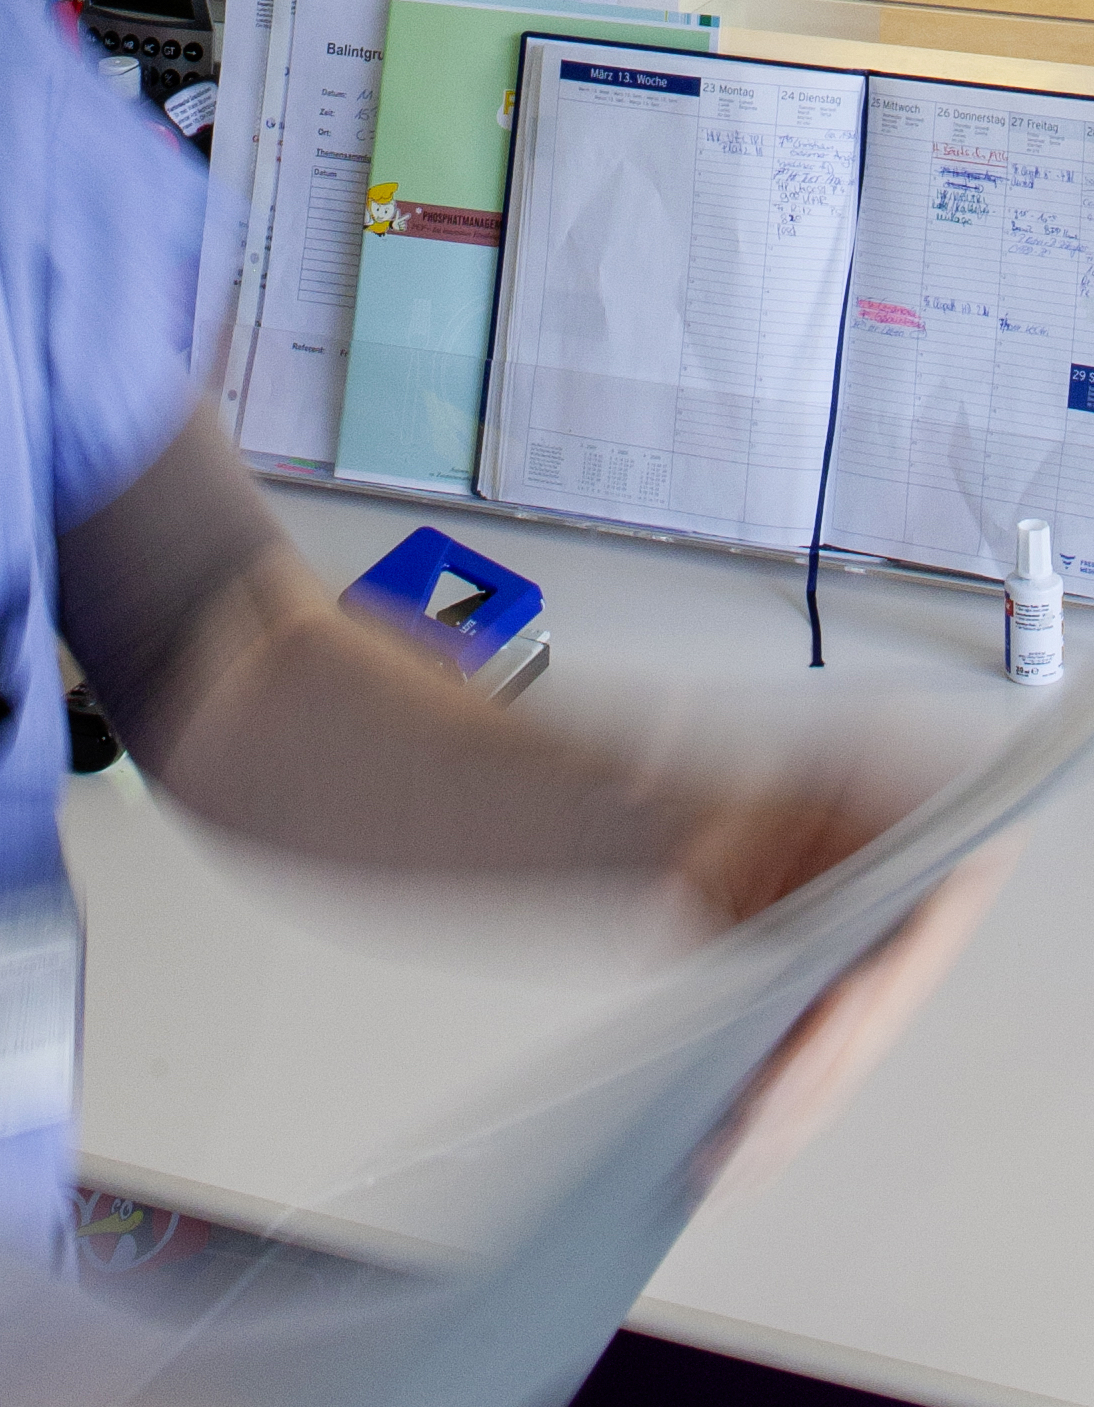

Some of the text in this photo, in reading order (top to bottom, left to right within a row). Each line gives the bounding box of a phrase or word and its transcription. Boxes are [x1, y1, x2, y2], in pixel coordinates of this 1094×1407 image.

[590, 68, 668, 88] März 13. Woche
[702, 82, 755, 99] 23 Montag
[781, 90, 842, 107] 24 Dienstag
[882, 100, 921, 115] Mittwoch
[937, 107, 1007, 128] 26 Donnerstag
[1011, 116, 1059, 134] 27 Freitag
[1072, 369, 1086, 381] 29
